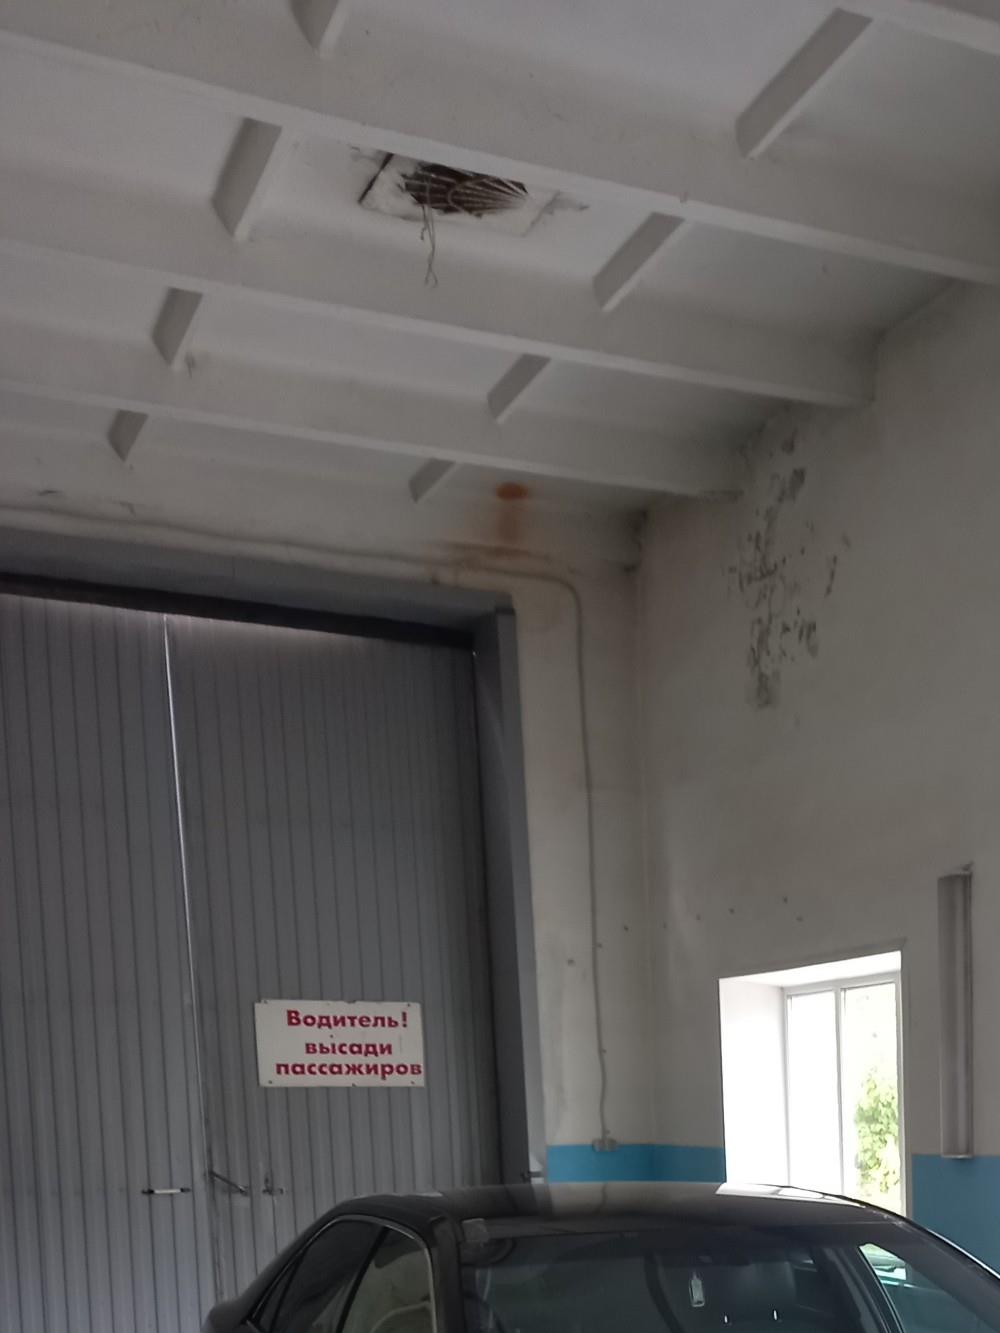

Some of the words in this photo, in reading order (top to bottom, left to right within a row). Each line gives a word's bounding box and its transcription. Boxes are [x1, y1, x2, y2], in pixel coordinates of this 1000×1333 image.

[286, 1009, 408, 1029] Водитель!
[305, 1042, 393, 1057] высади
[276, 1062, 422, 1080] пассажиров
